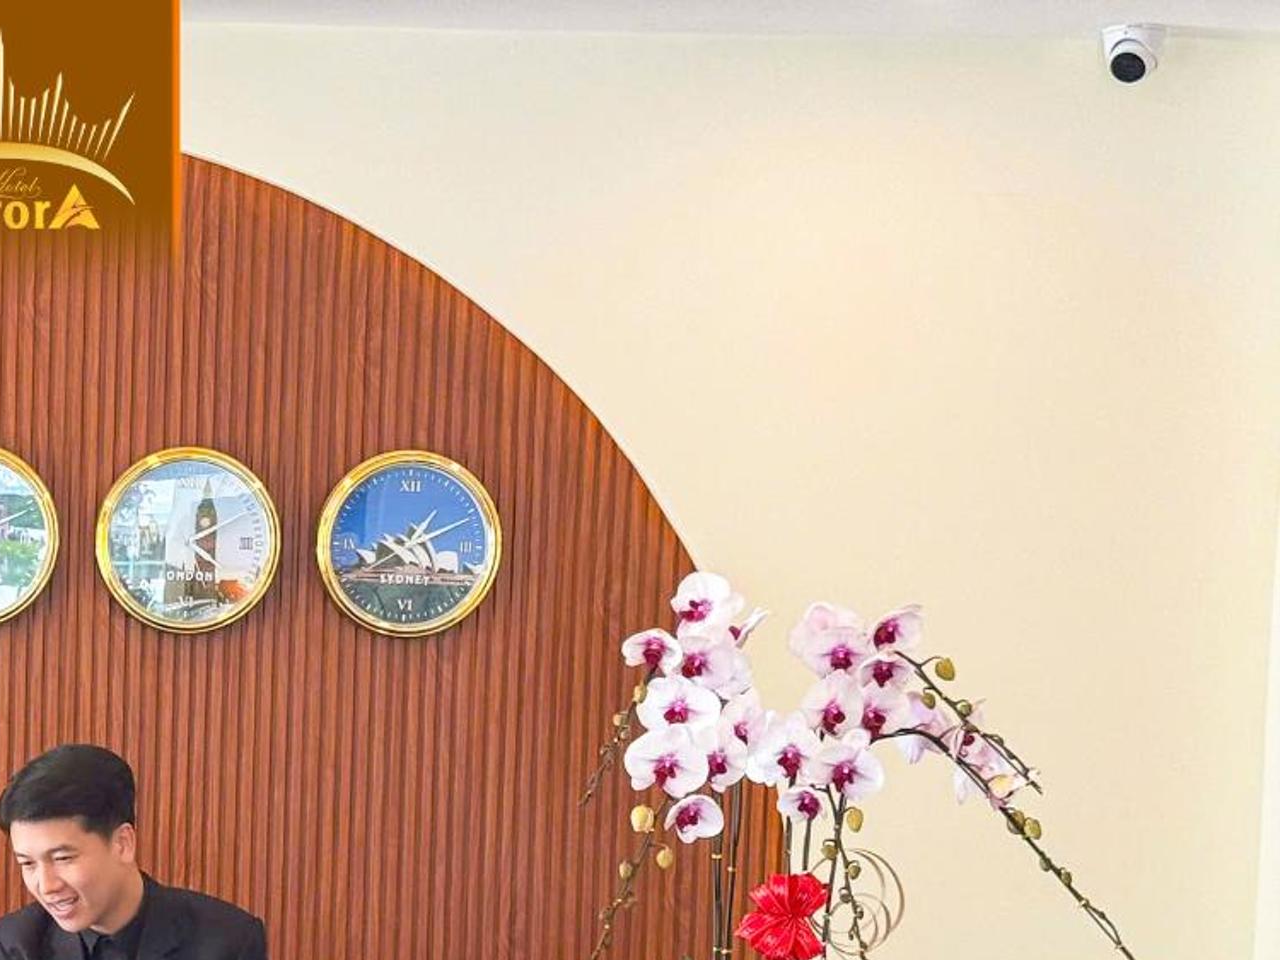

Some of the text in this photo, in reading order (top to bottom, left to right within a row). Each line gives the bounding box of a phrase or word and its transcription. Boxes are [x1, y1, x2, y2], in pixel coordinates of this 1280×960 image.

[400, 481, 422, 493] XII
[157, 570, 214, 582] ONDON
[379, 573, 431, 587] SYDNEY
[397, 599, 414, 611] VI
